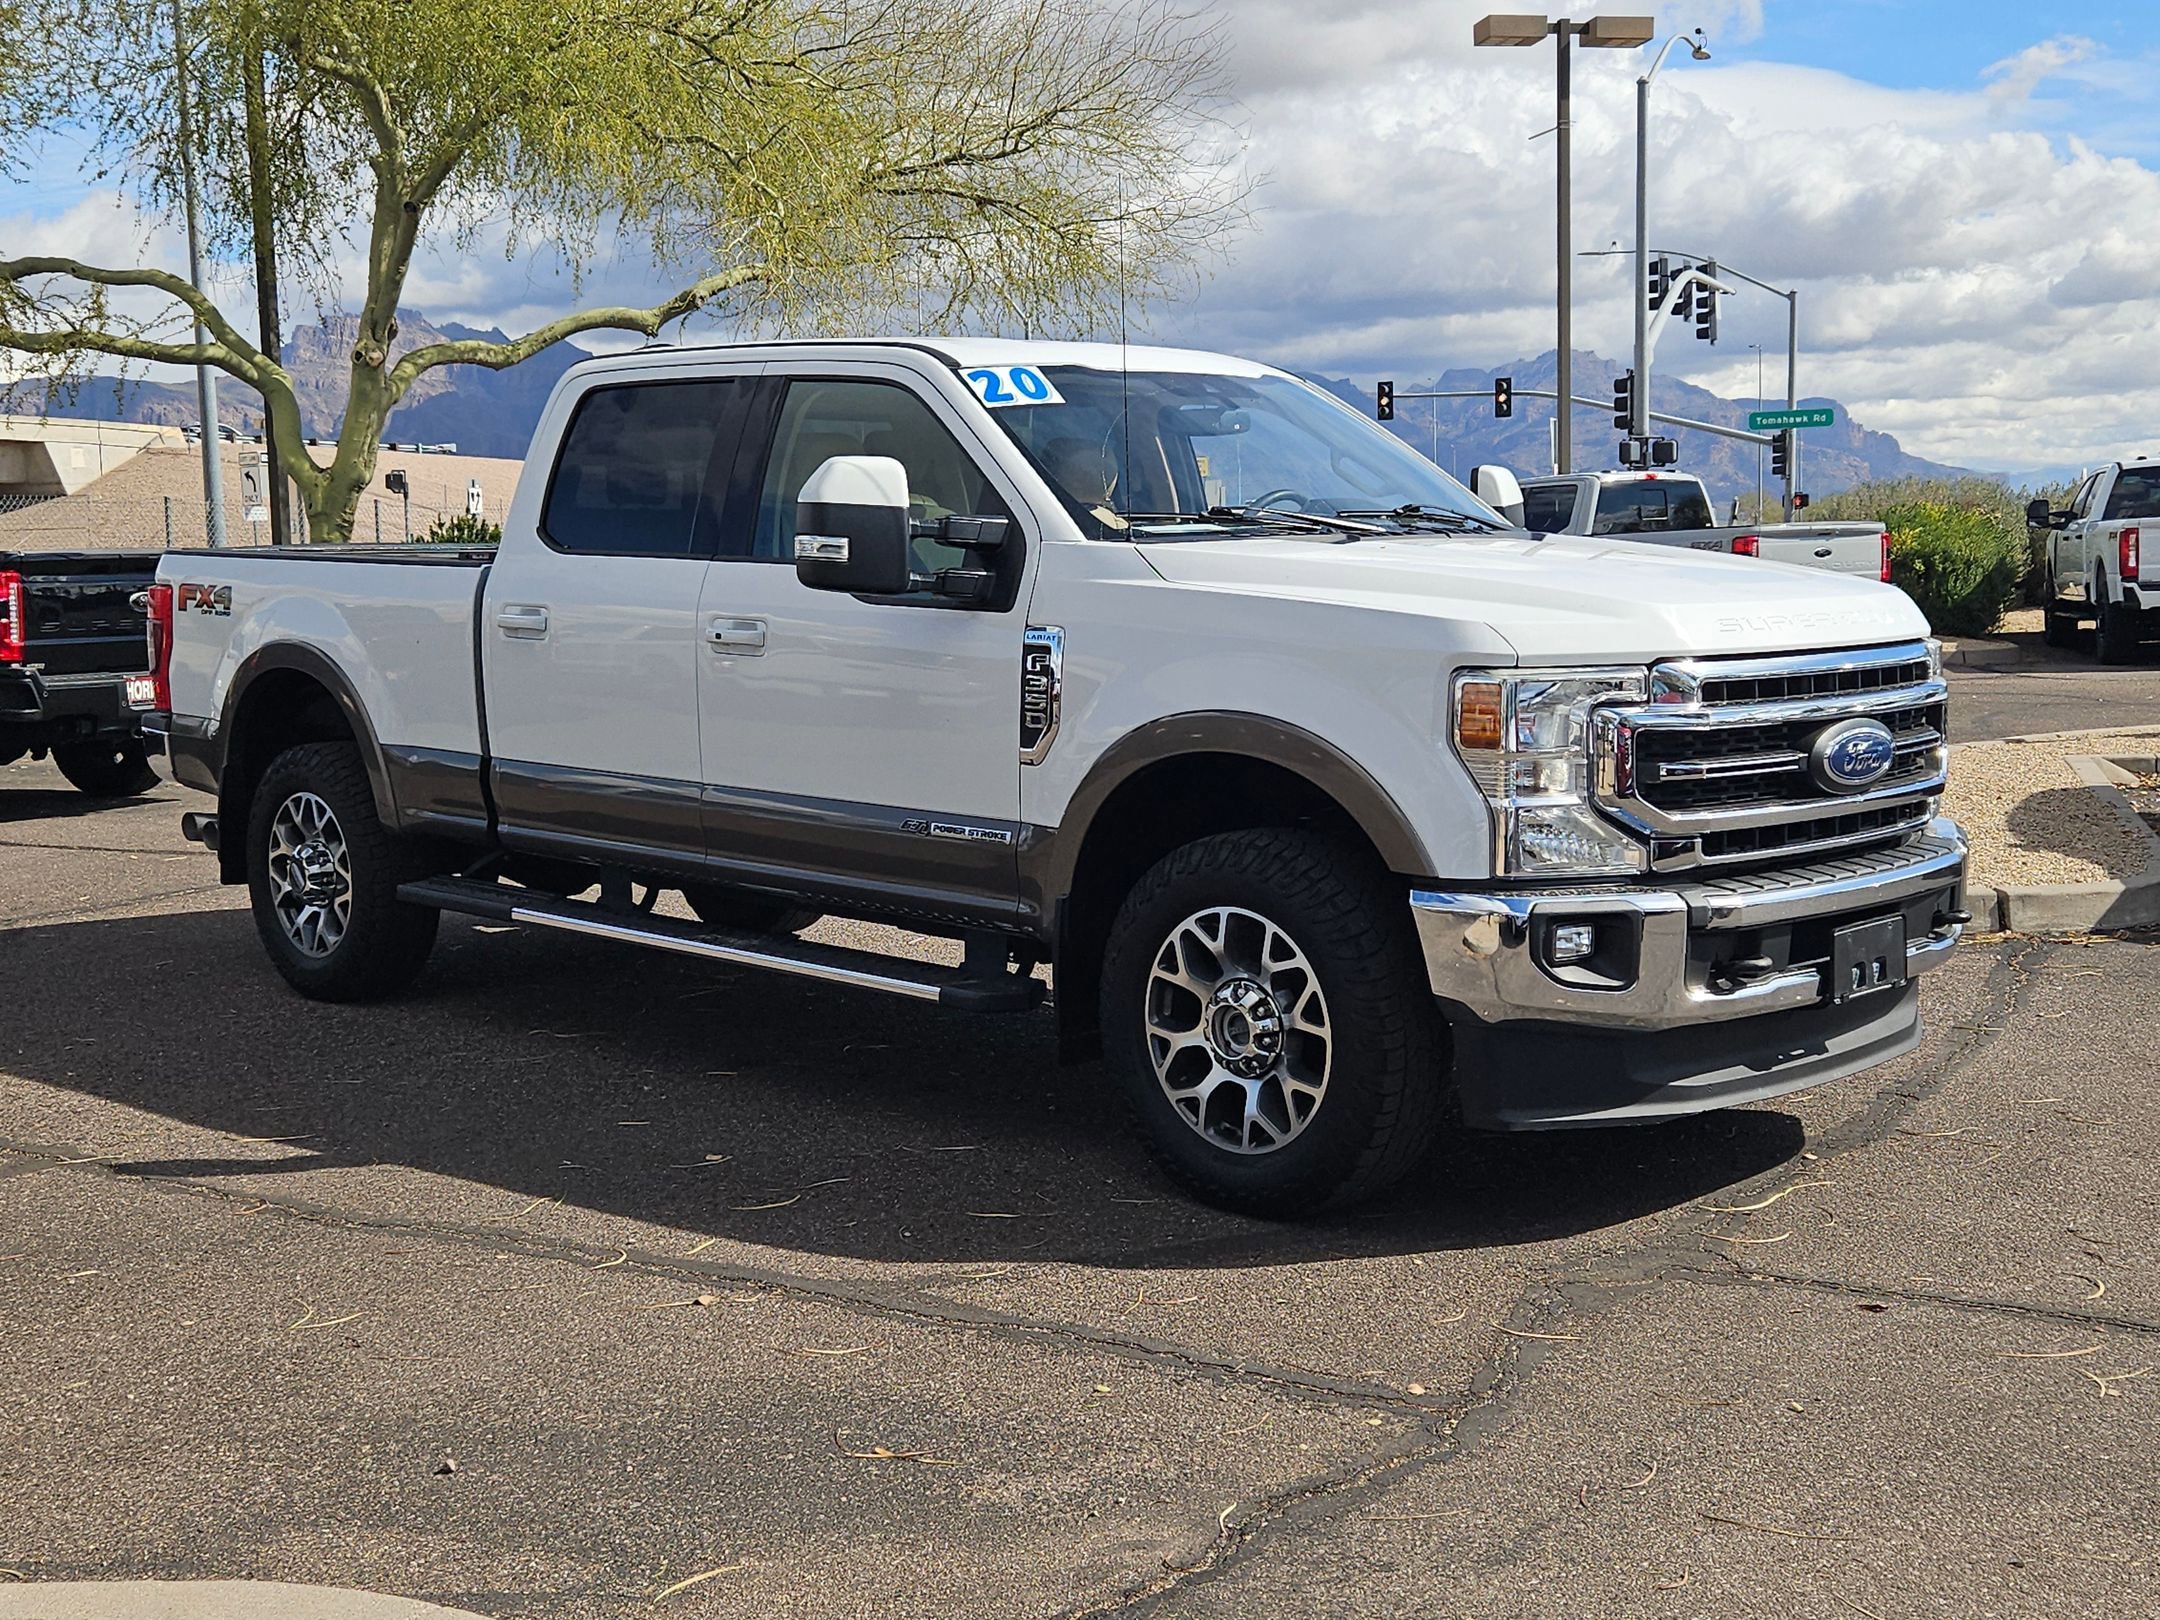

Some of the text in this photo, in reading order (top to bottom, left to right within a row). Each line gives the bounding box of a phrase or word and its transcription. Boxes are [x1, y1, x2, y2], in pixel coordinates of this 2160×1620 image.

[966, 367, 1049, 403] 20
[1756, 414, 1827, 425] Tomahawk Rd
[178, 583, 232, 611] FX4
[1026, 633, 1056, 641] LARIAT
[1844, 740, 1882, 772] Ford
[932, 824, 966, 836] POWER
[967, 829, 1007, 841] STROKE
